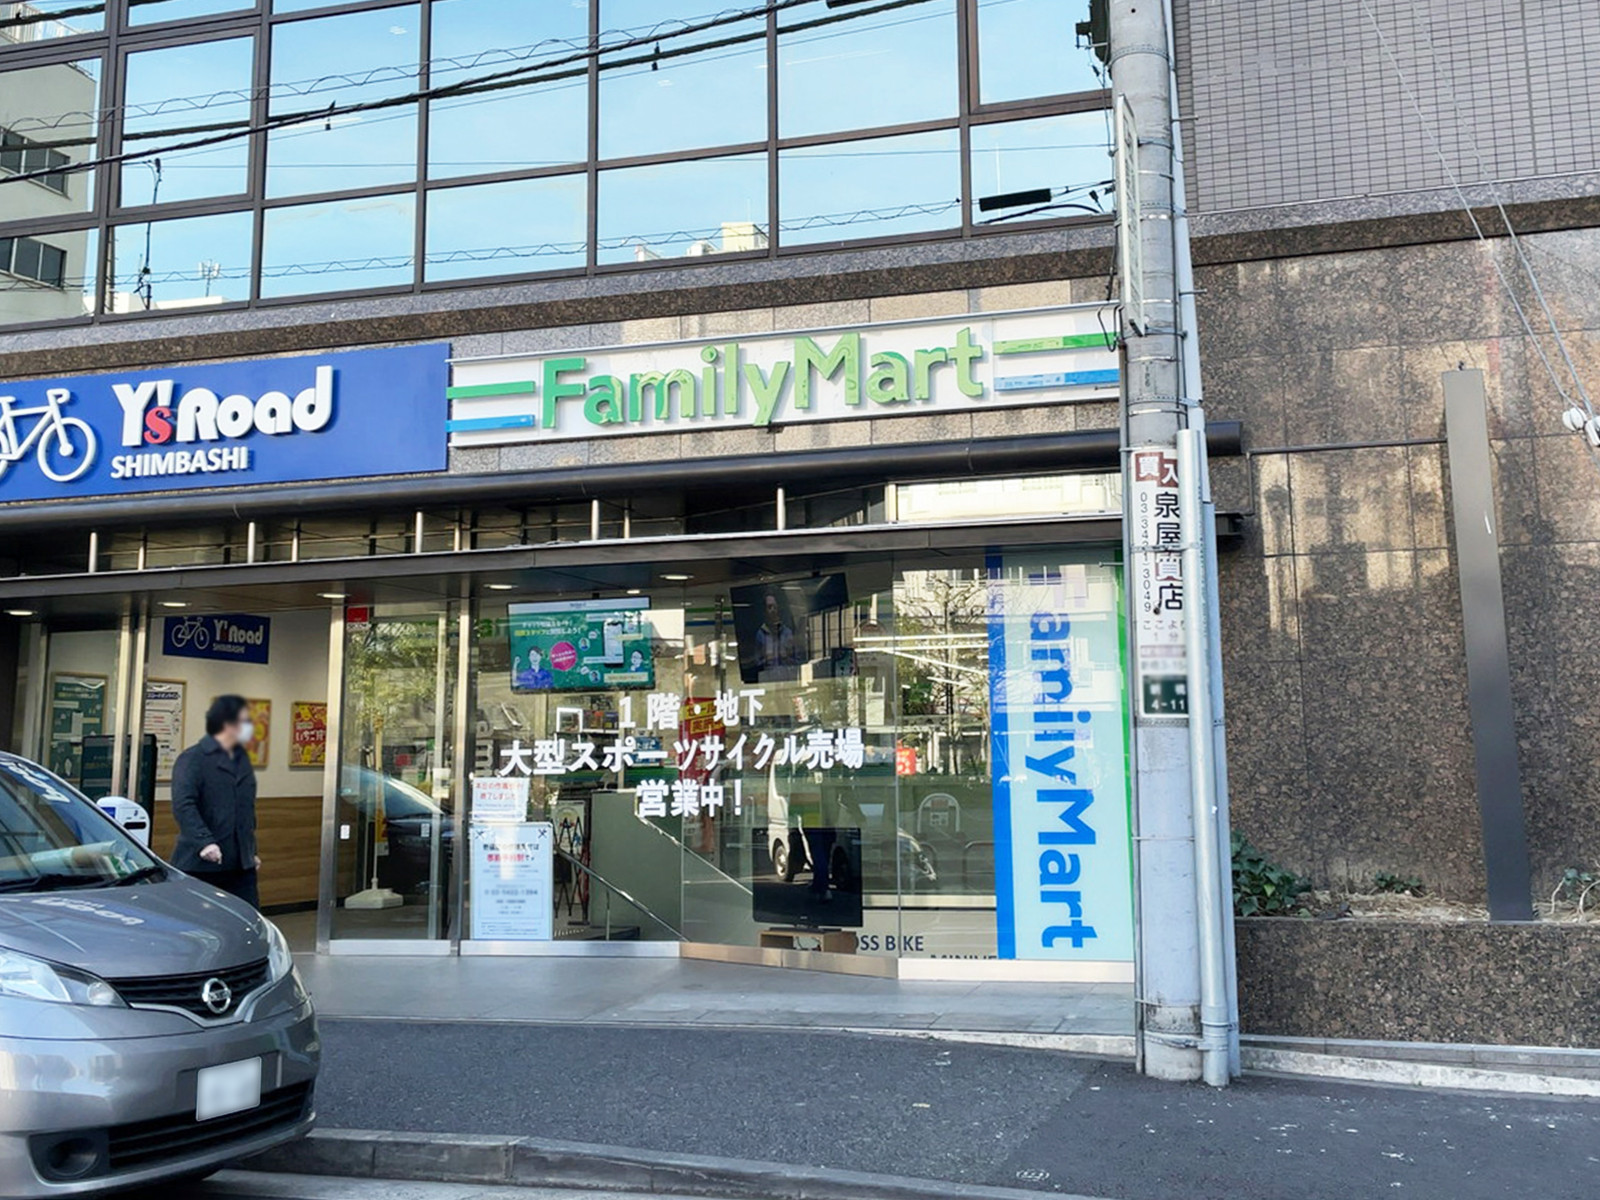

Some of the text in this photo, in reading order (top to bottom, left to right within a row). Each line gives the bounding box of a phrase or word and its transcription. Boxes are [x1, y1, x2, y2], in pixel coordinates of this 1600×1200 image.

[541, 328, 984, 427] FamilyMart
[110, 446, 249, 479] SHIMBASHI
[498, 728, 865, 777] 大型スポーツサイクル売場
[635, 779, 745, 819] 営業中！
[854, 934, 880, 951] SS
